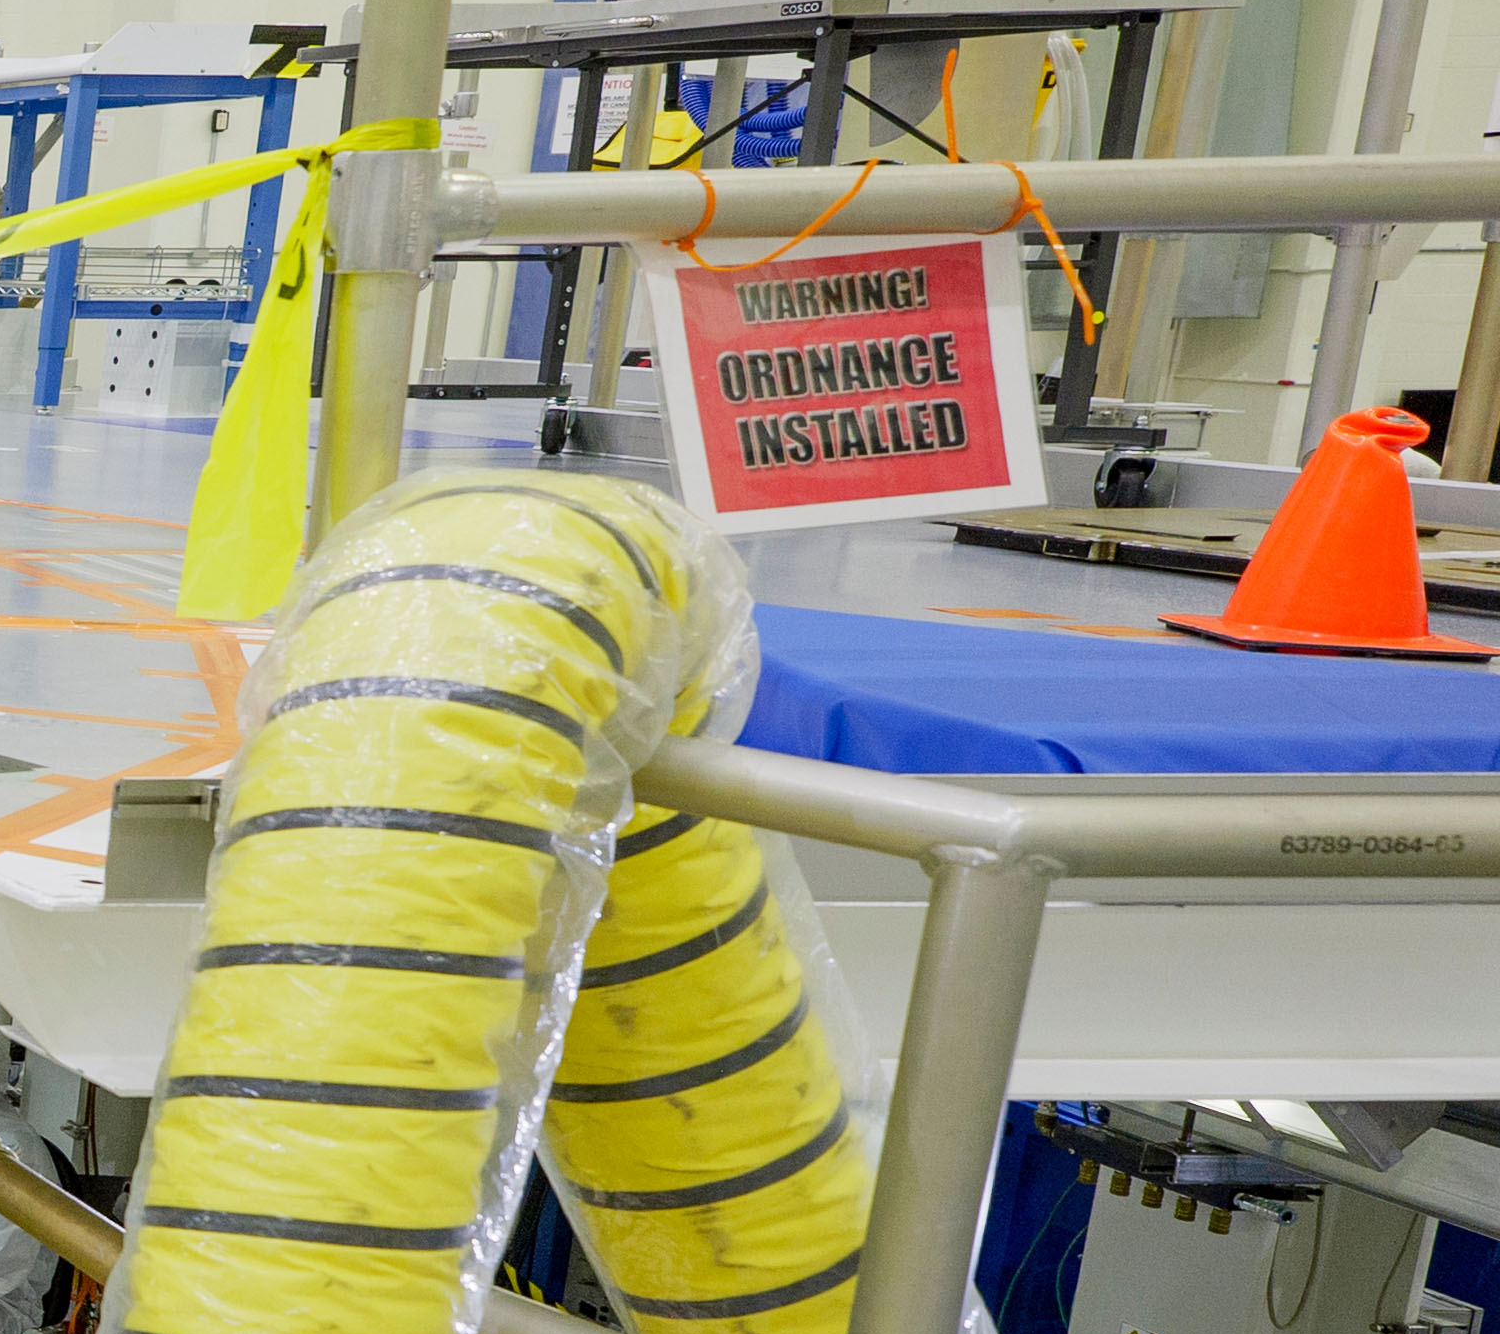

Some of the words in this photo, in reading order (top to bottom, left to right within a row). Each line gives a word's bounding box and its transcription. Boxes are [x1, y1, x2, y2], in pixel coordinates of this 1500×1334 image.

[781, 1, 820, 16] COSCO
[734, 266, 929, 325] WARNING!
[716, 331, 961, 404] ORDNANCE
[734, 398, 968, 469] INSTALLED
